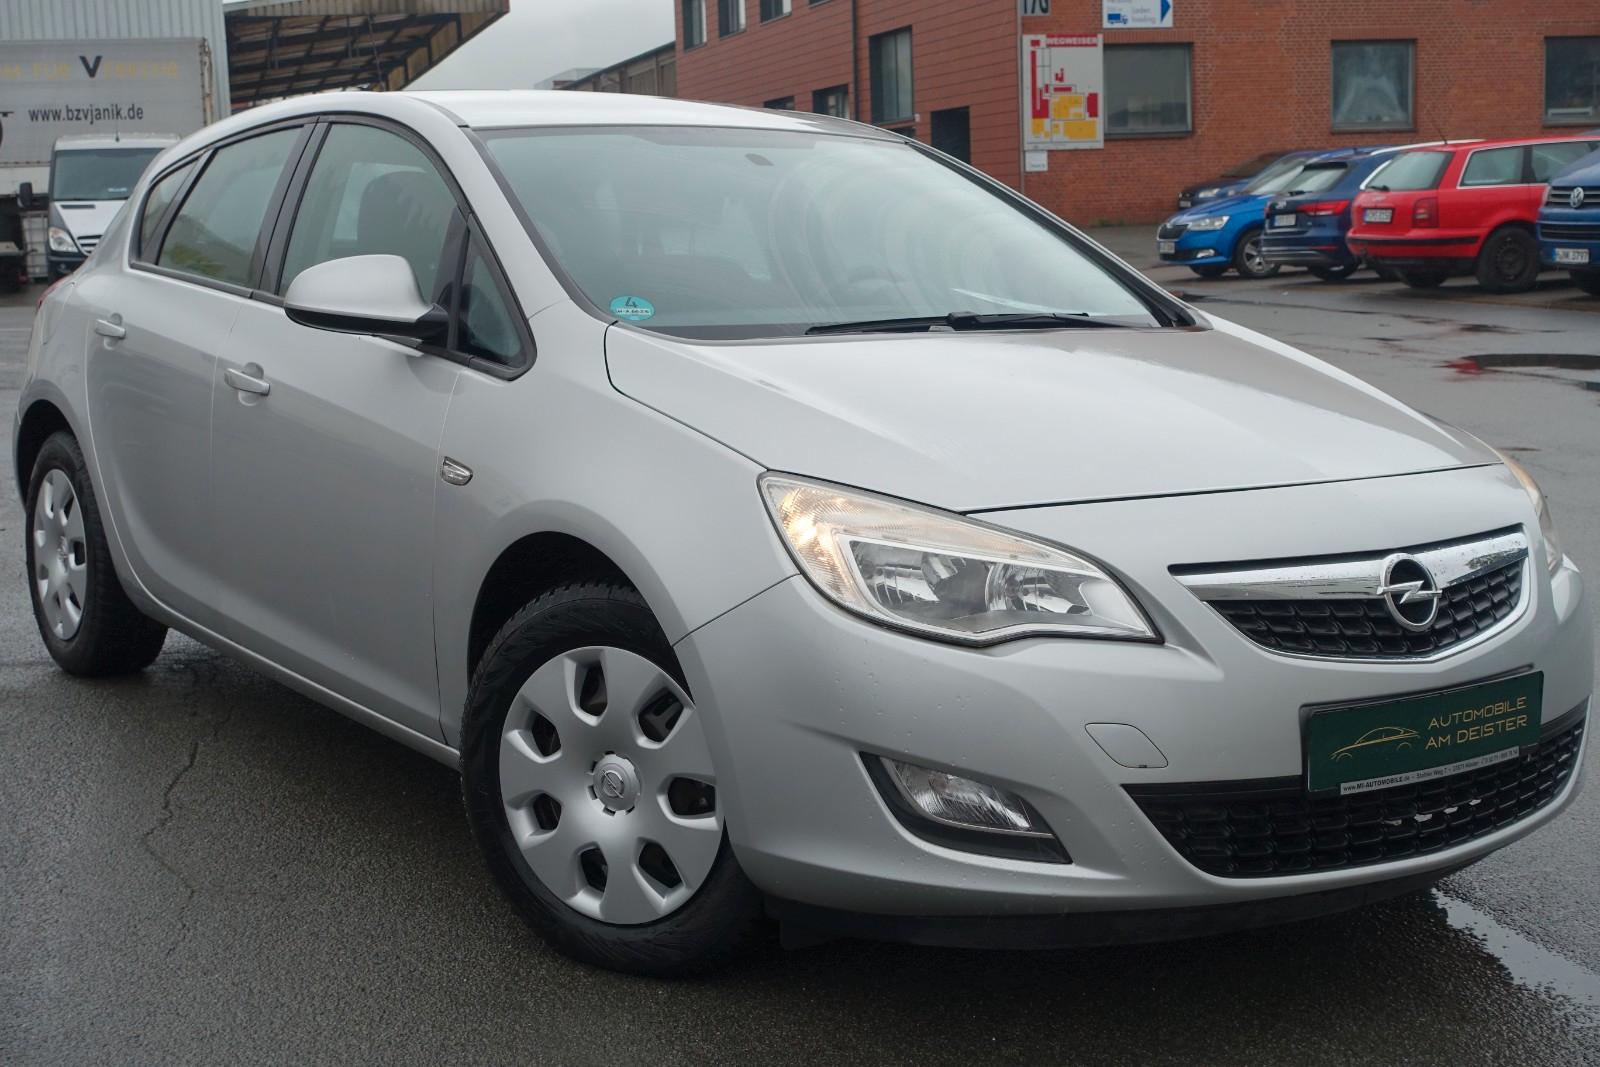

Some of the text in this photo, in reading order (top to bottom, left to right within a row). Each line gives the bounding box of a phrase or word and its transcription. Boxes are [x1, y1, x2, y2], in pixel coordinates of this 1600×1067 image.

[28, 104, 144, 125] www.bzvjanik.de
[625, 297, 639, 308] 4
[1428, 696, 1527, 730] AUTOMOBILE
[1425, 714, 1528, 750] AM DEISTER
